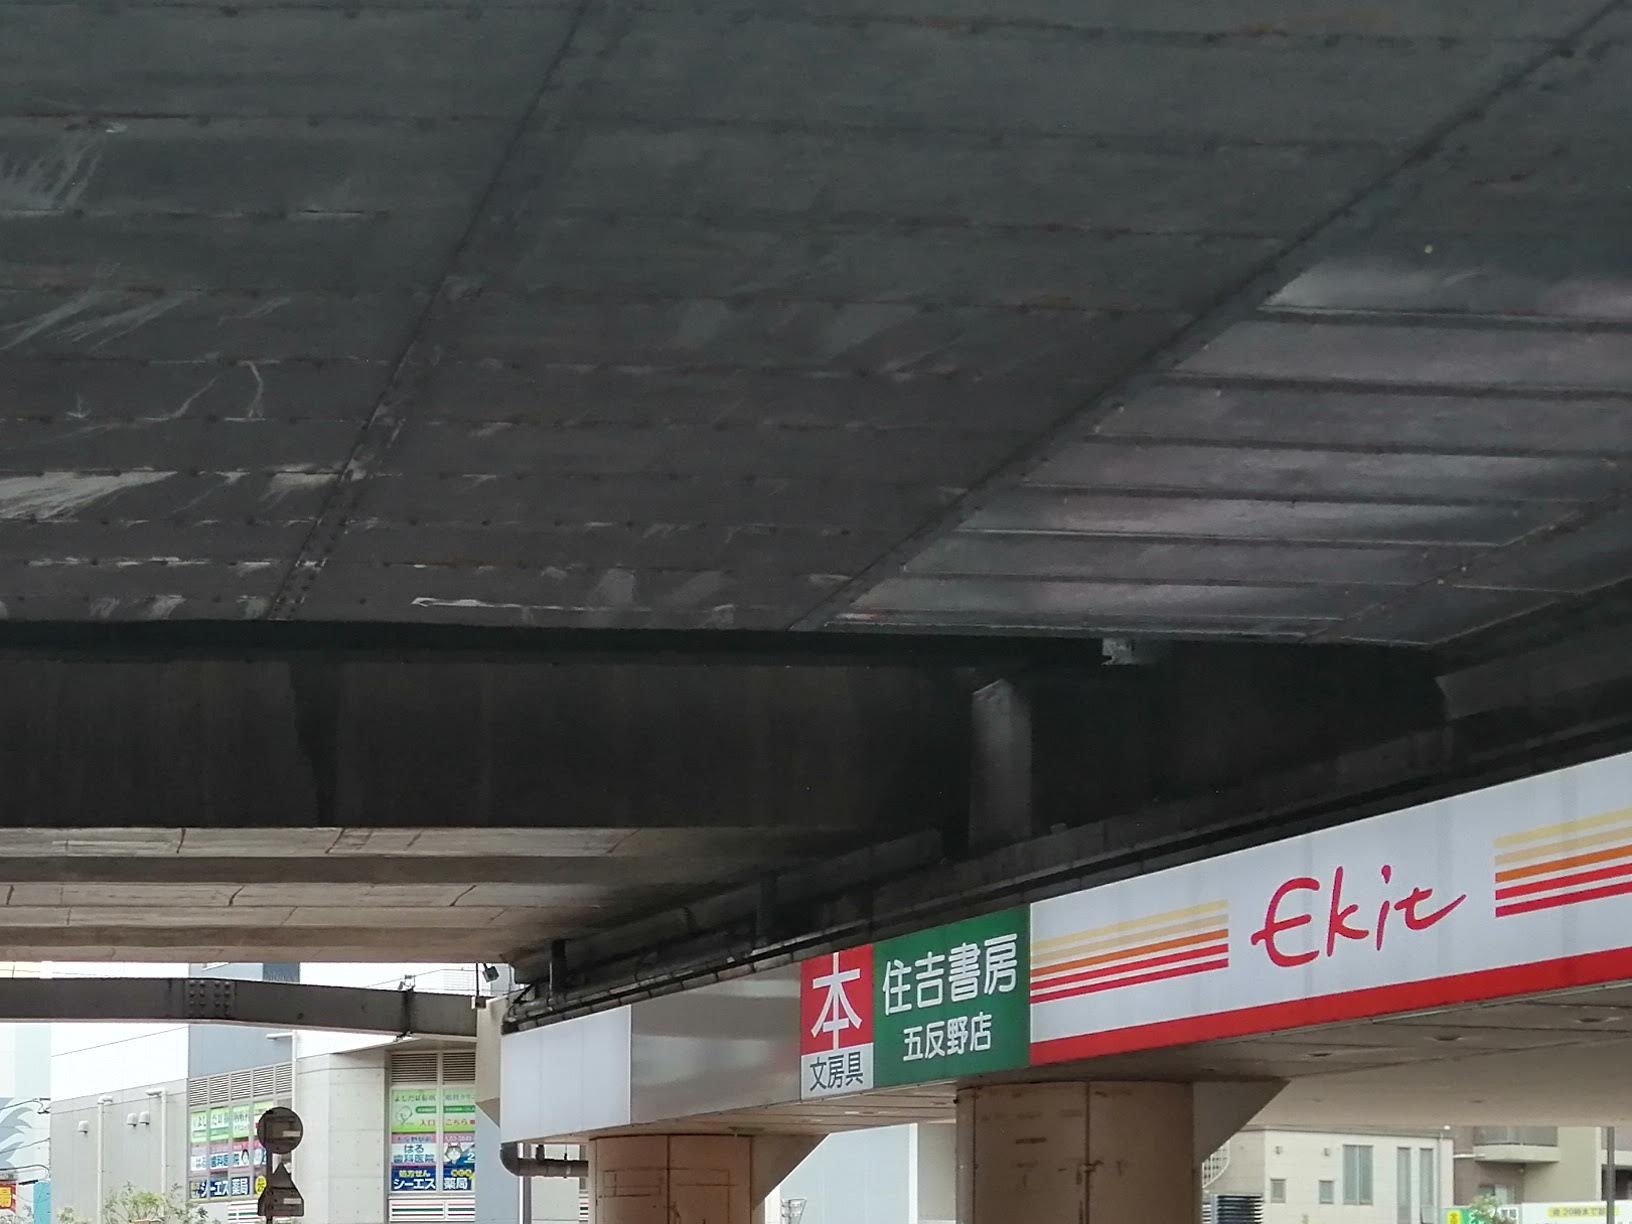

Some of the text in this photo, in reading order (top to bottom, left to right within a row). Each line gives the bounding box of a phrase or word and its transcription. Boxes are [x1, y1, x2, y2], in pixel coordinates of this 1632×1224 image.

[1251, 865, 1467, 967] Ekit
[811, 952, 863, 1051] 本
[883, 933, 1018, 1016] 住吉書房
[810, 1051, 864, 1092] 文房具
[903, 1012, 992, 1062] 五反野店
